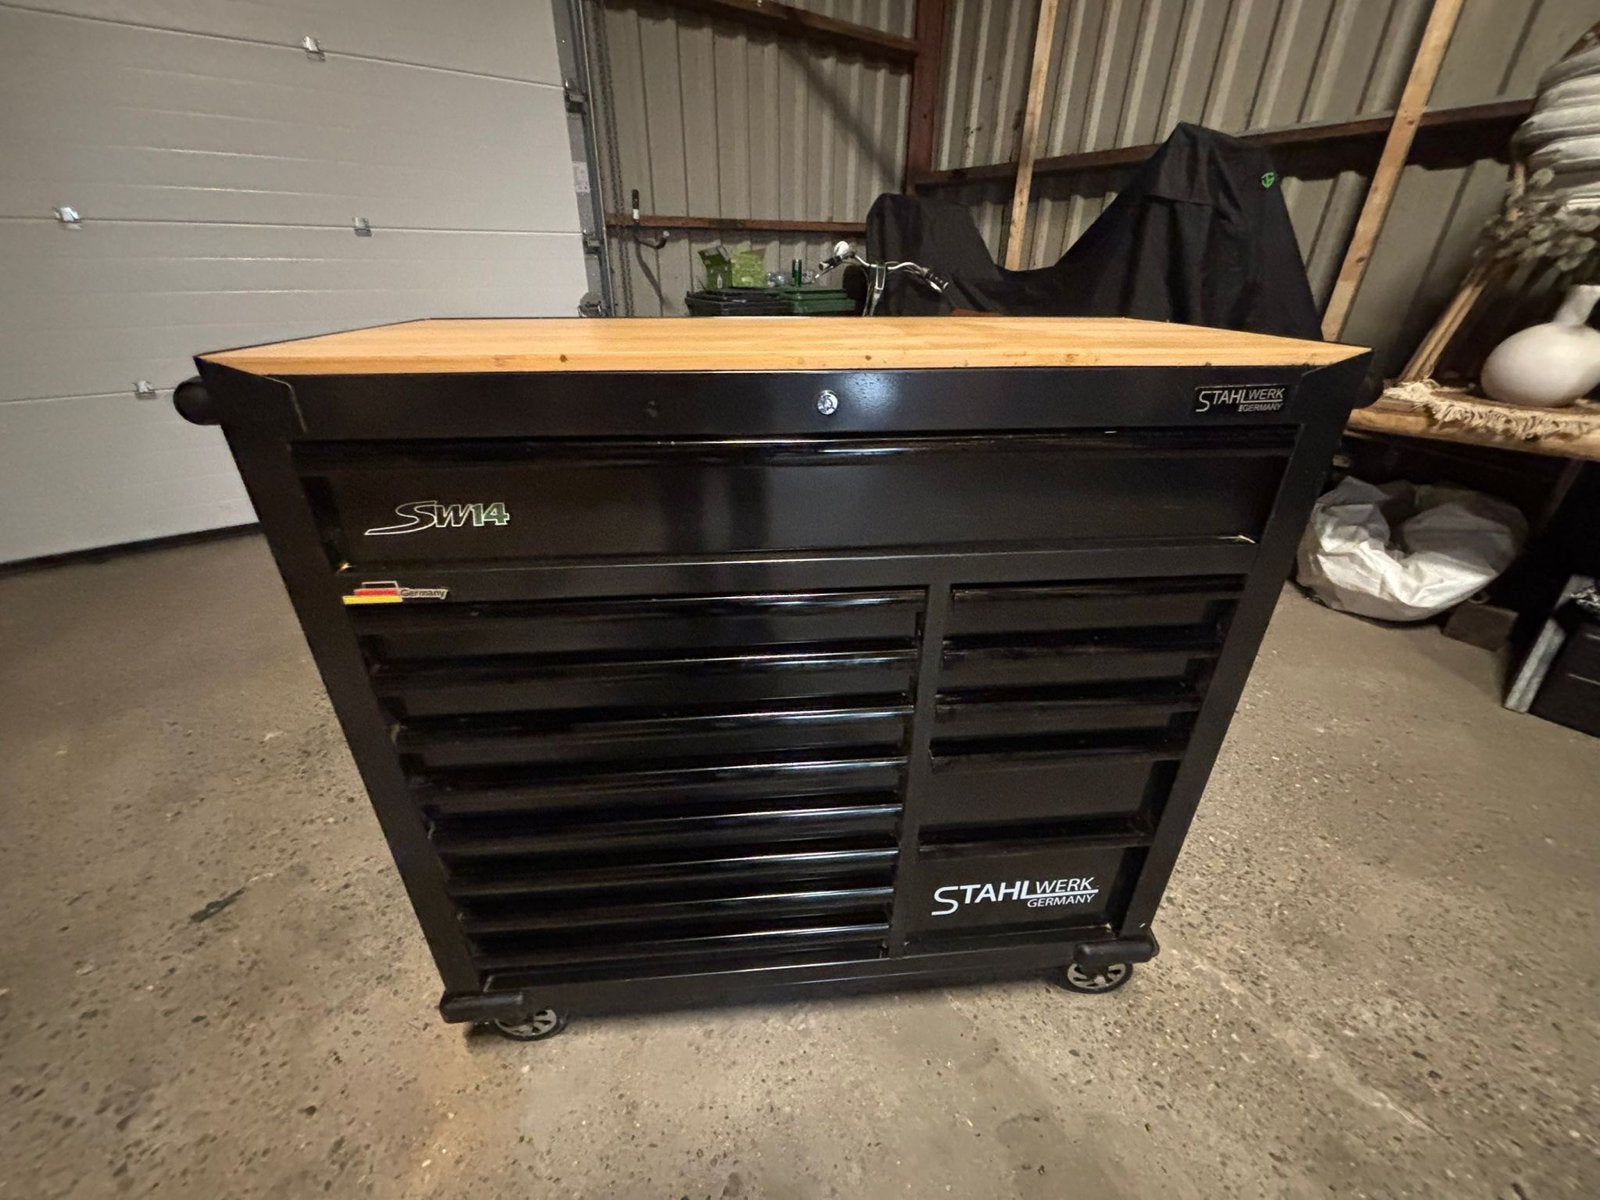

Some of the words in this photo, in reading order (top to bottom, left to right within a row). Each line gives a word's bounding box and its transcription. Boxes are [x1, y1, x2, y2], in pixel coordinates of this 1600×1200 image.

[1195, 388, 1285, 412] STAHLWERK
[1242, 403, 1283, 412] GERMANY
[400, 589, 446, 598] Germany
[931, 877, 1099, 916] STAHLWERK
[1027, 894, 1095, 908] GERMANY
